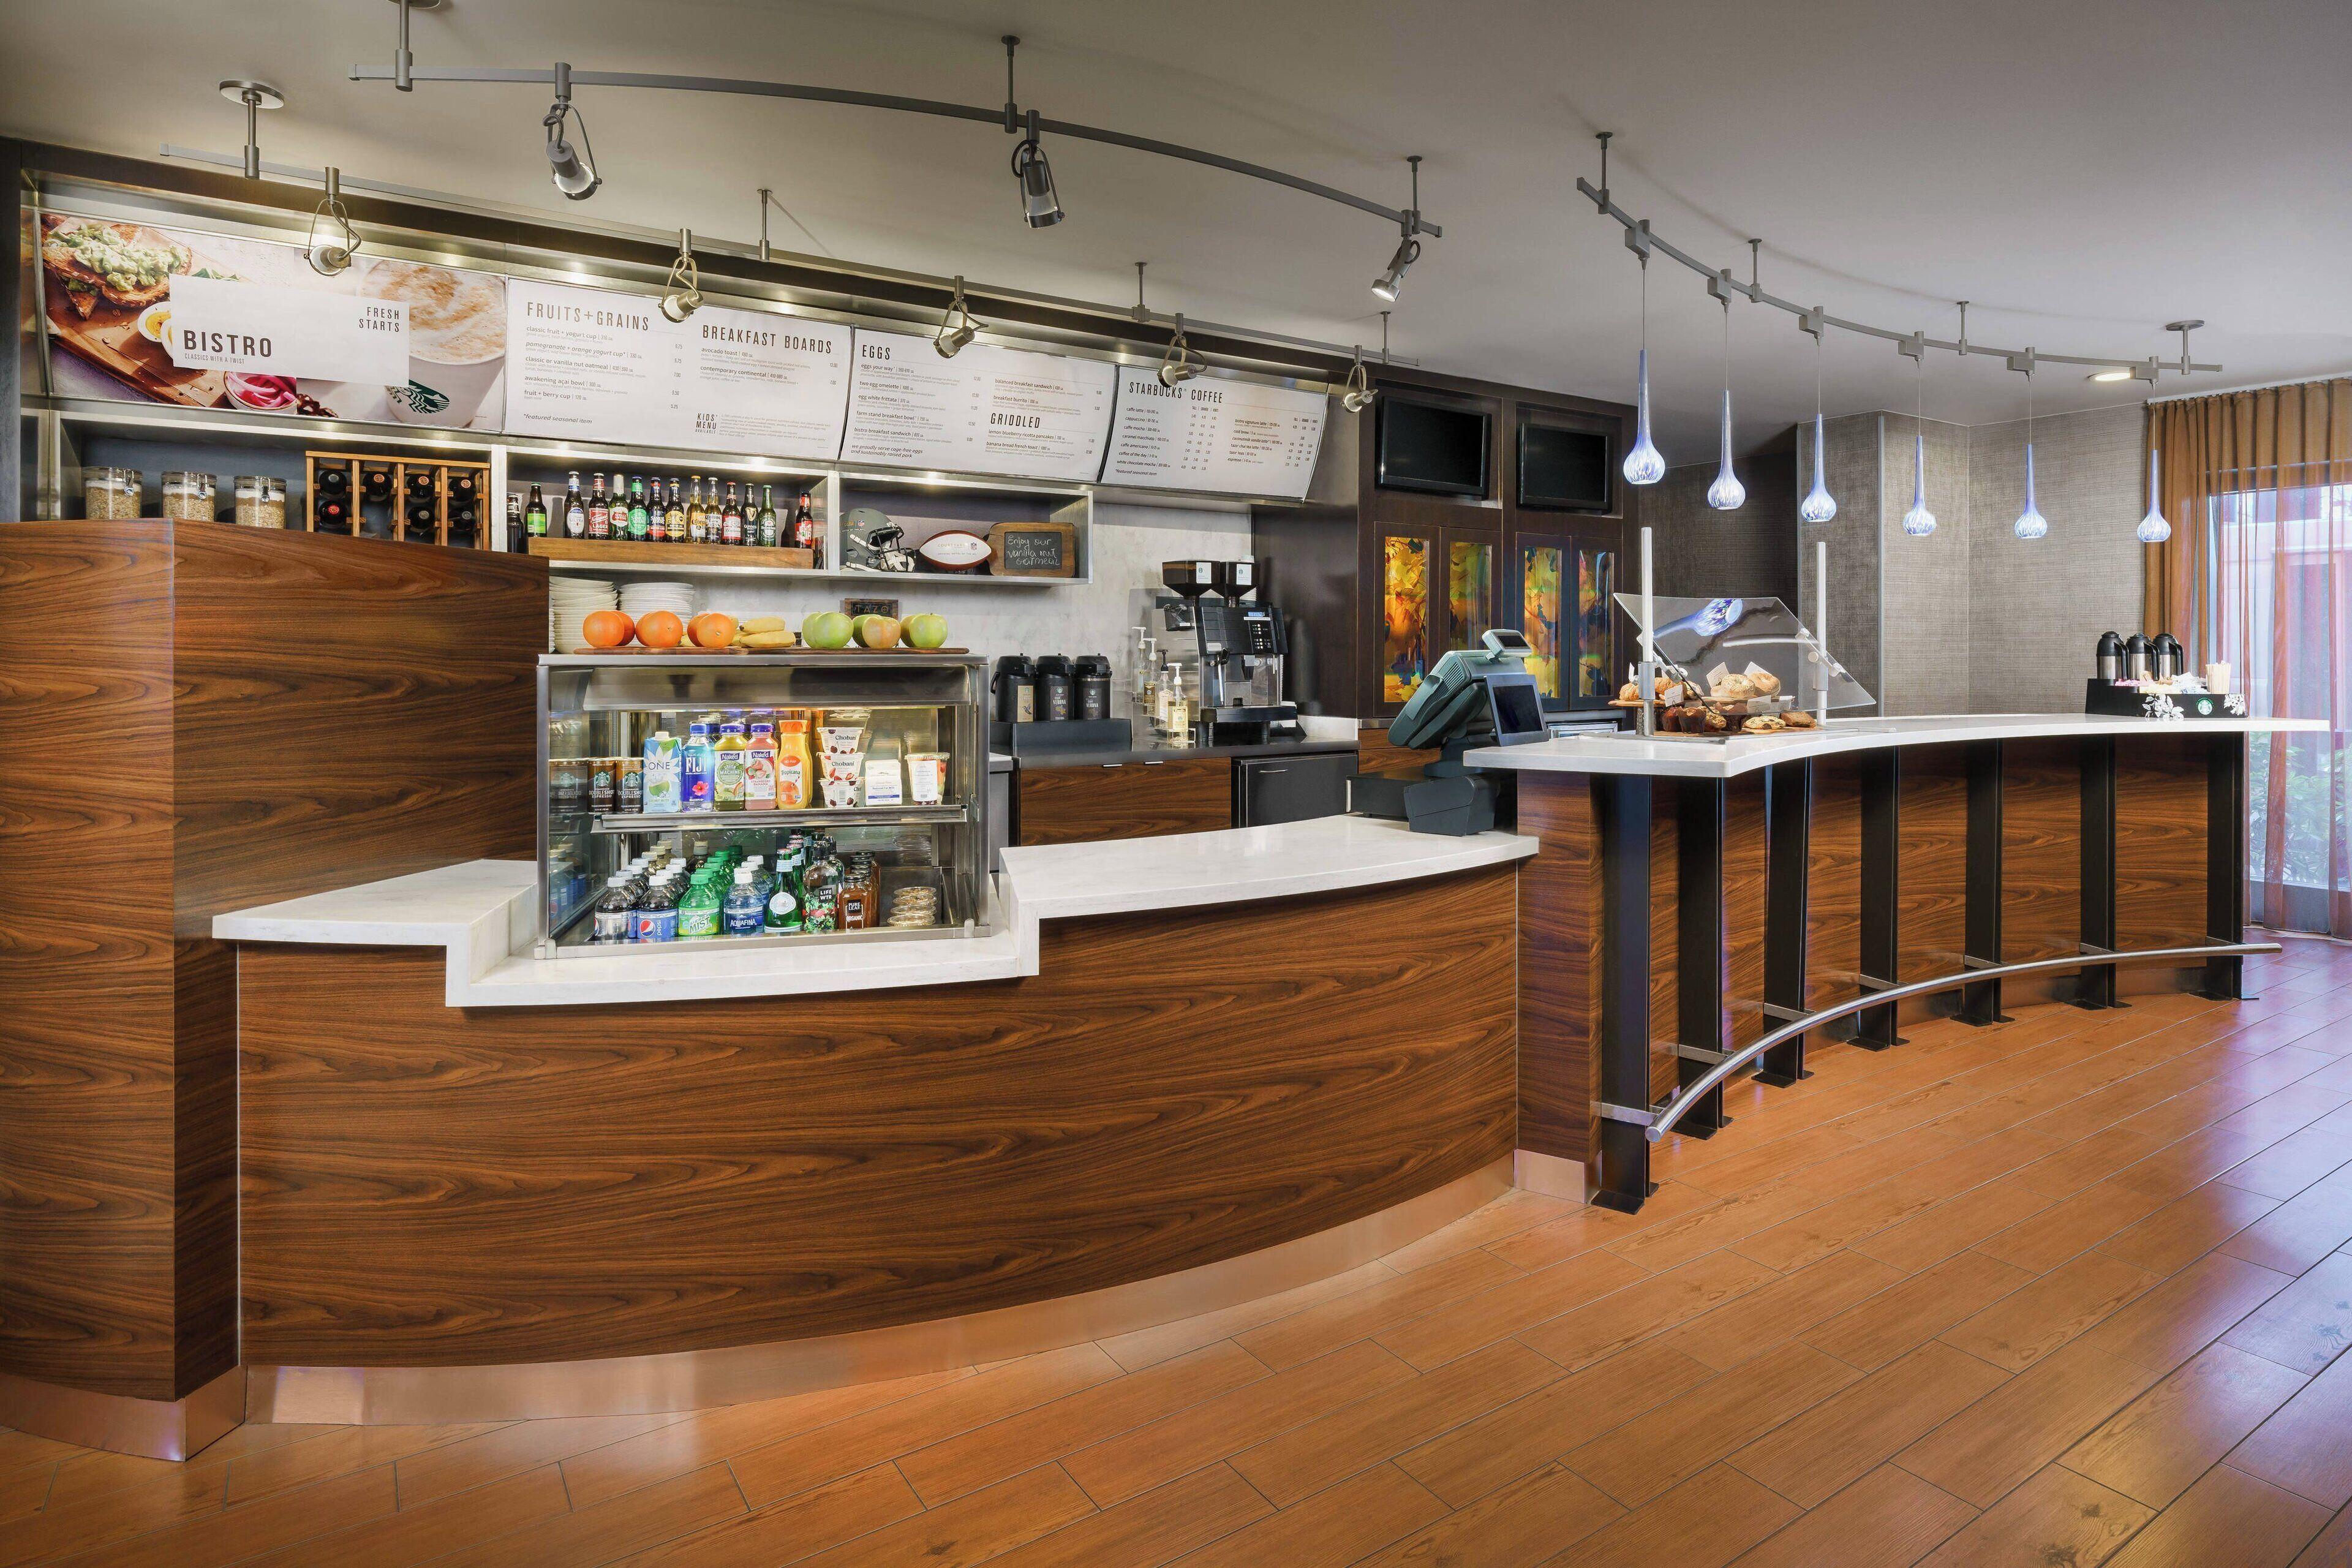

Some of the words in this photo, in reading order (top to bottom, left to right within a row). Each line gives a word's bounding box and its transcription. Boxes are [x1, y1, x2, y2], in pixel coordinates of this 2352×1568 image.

[367, 307, 399, 320] FRESH
[527, 301, 649, 331] FRUITS+GRAINS
[359, 318, 399, 333] STARTS
[184, 330, 272, 358] BISTRO
[526, 341, 565, 350] pomegranate
[703, 325, 777, 347] BREAKFAST
[785, 336, 831, 354] BOARDS
[862, 345, 890, 360] EGGS
[700, 366, 737, 375] contemporary
[738, 369, 766, 377] continental
[525, 375, 556, 385] awakening
[1191, 390, 1223, 403] COFFEE
[696, 421, 717, 429] MENU
[991, 413, 1040, 428] GRIDDLED
[1008, 535, 1030, 551] Enjoy
[855, 605, 889, 614] TAZO
[686, 757, 706, 772] FIJI
[689, 917, 710, 932] MIST
